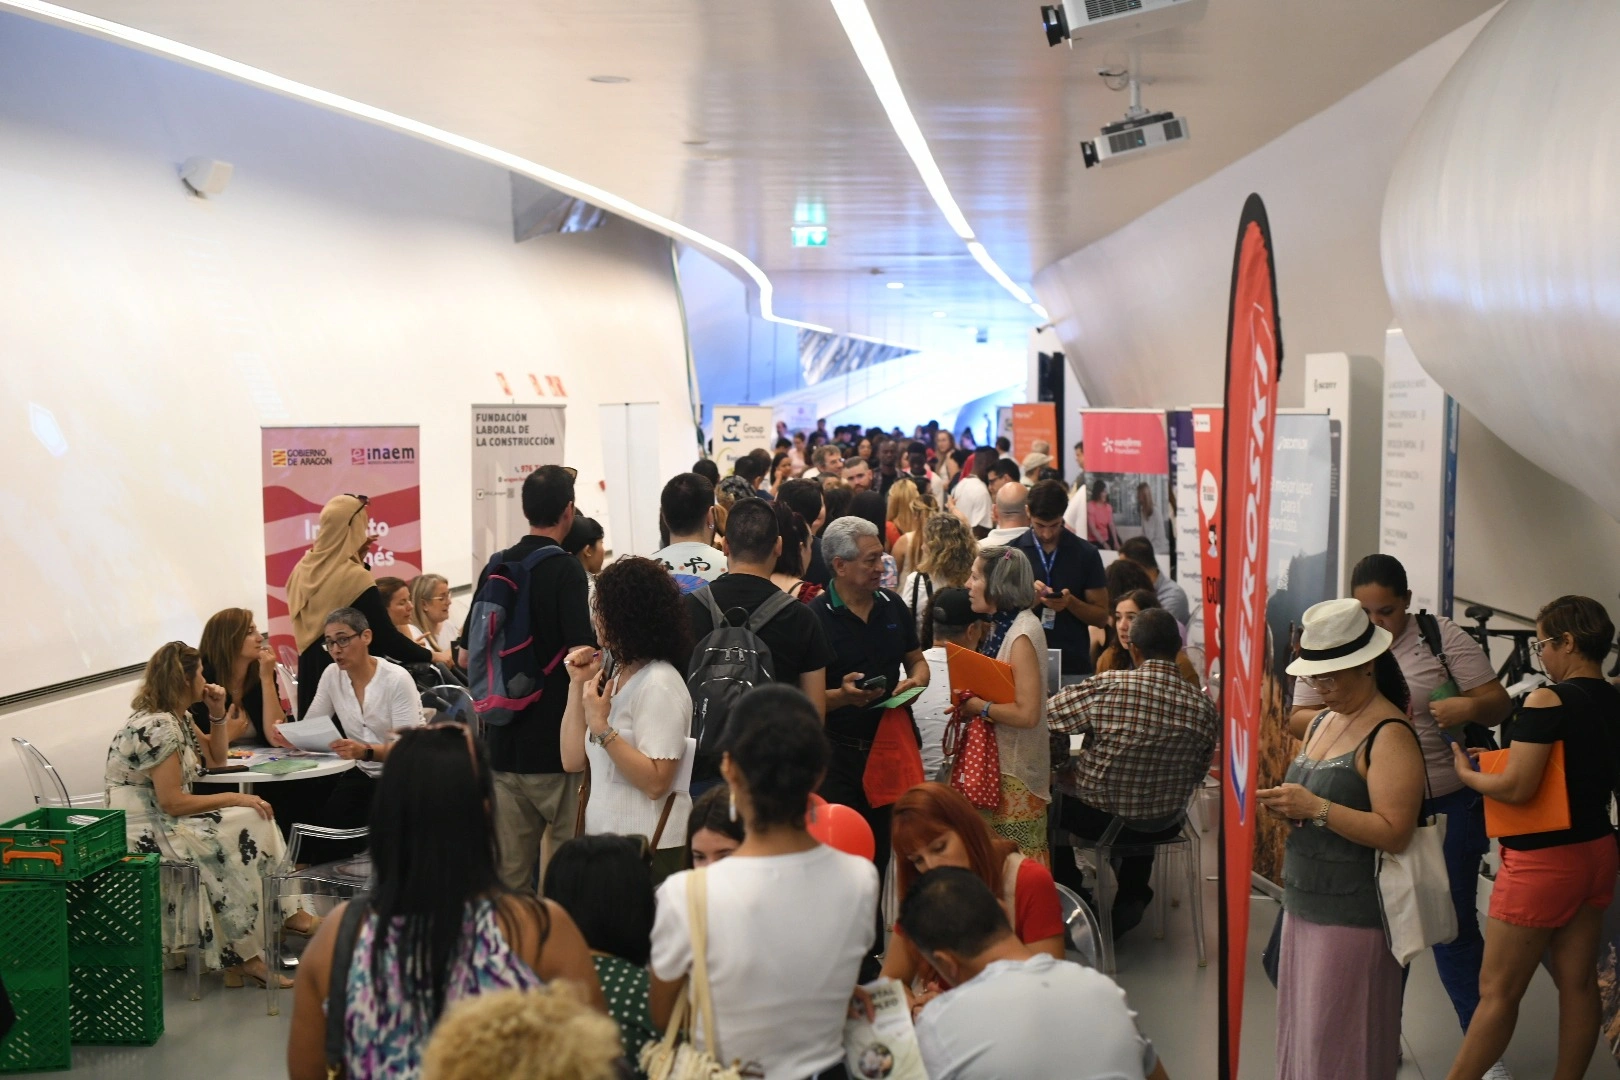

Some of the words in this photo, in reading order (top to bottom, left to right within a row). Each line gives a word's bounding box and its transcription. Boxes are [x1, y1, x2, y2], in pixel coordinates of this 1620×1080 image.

[476, 410, 527, 422] FUNDACIÓN
[476, 425, 516, 435] LABORAL
[518, 425, 530, 434] DE
[476, 438, 487, 447] LA
[489, 434, 555, 446] CONSTRUCCIÓN
[287, 449, 327, 458] GOBIERNO
[367, 447, 415, 460] inaem
[287, 458, 298, 466] DE
[301, 457, 333, 465] ARAGON
[1238, 343, 1268, 681] EROSKI
